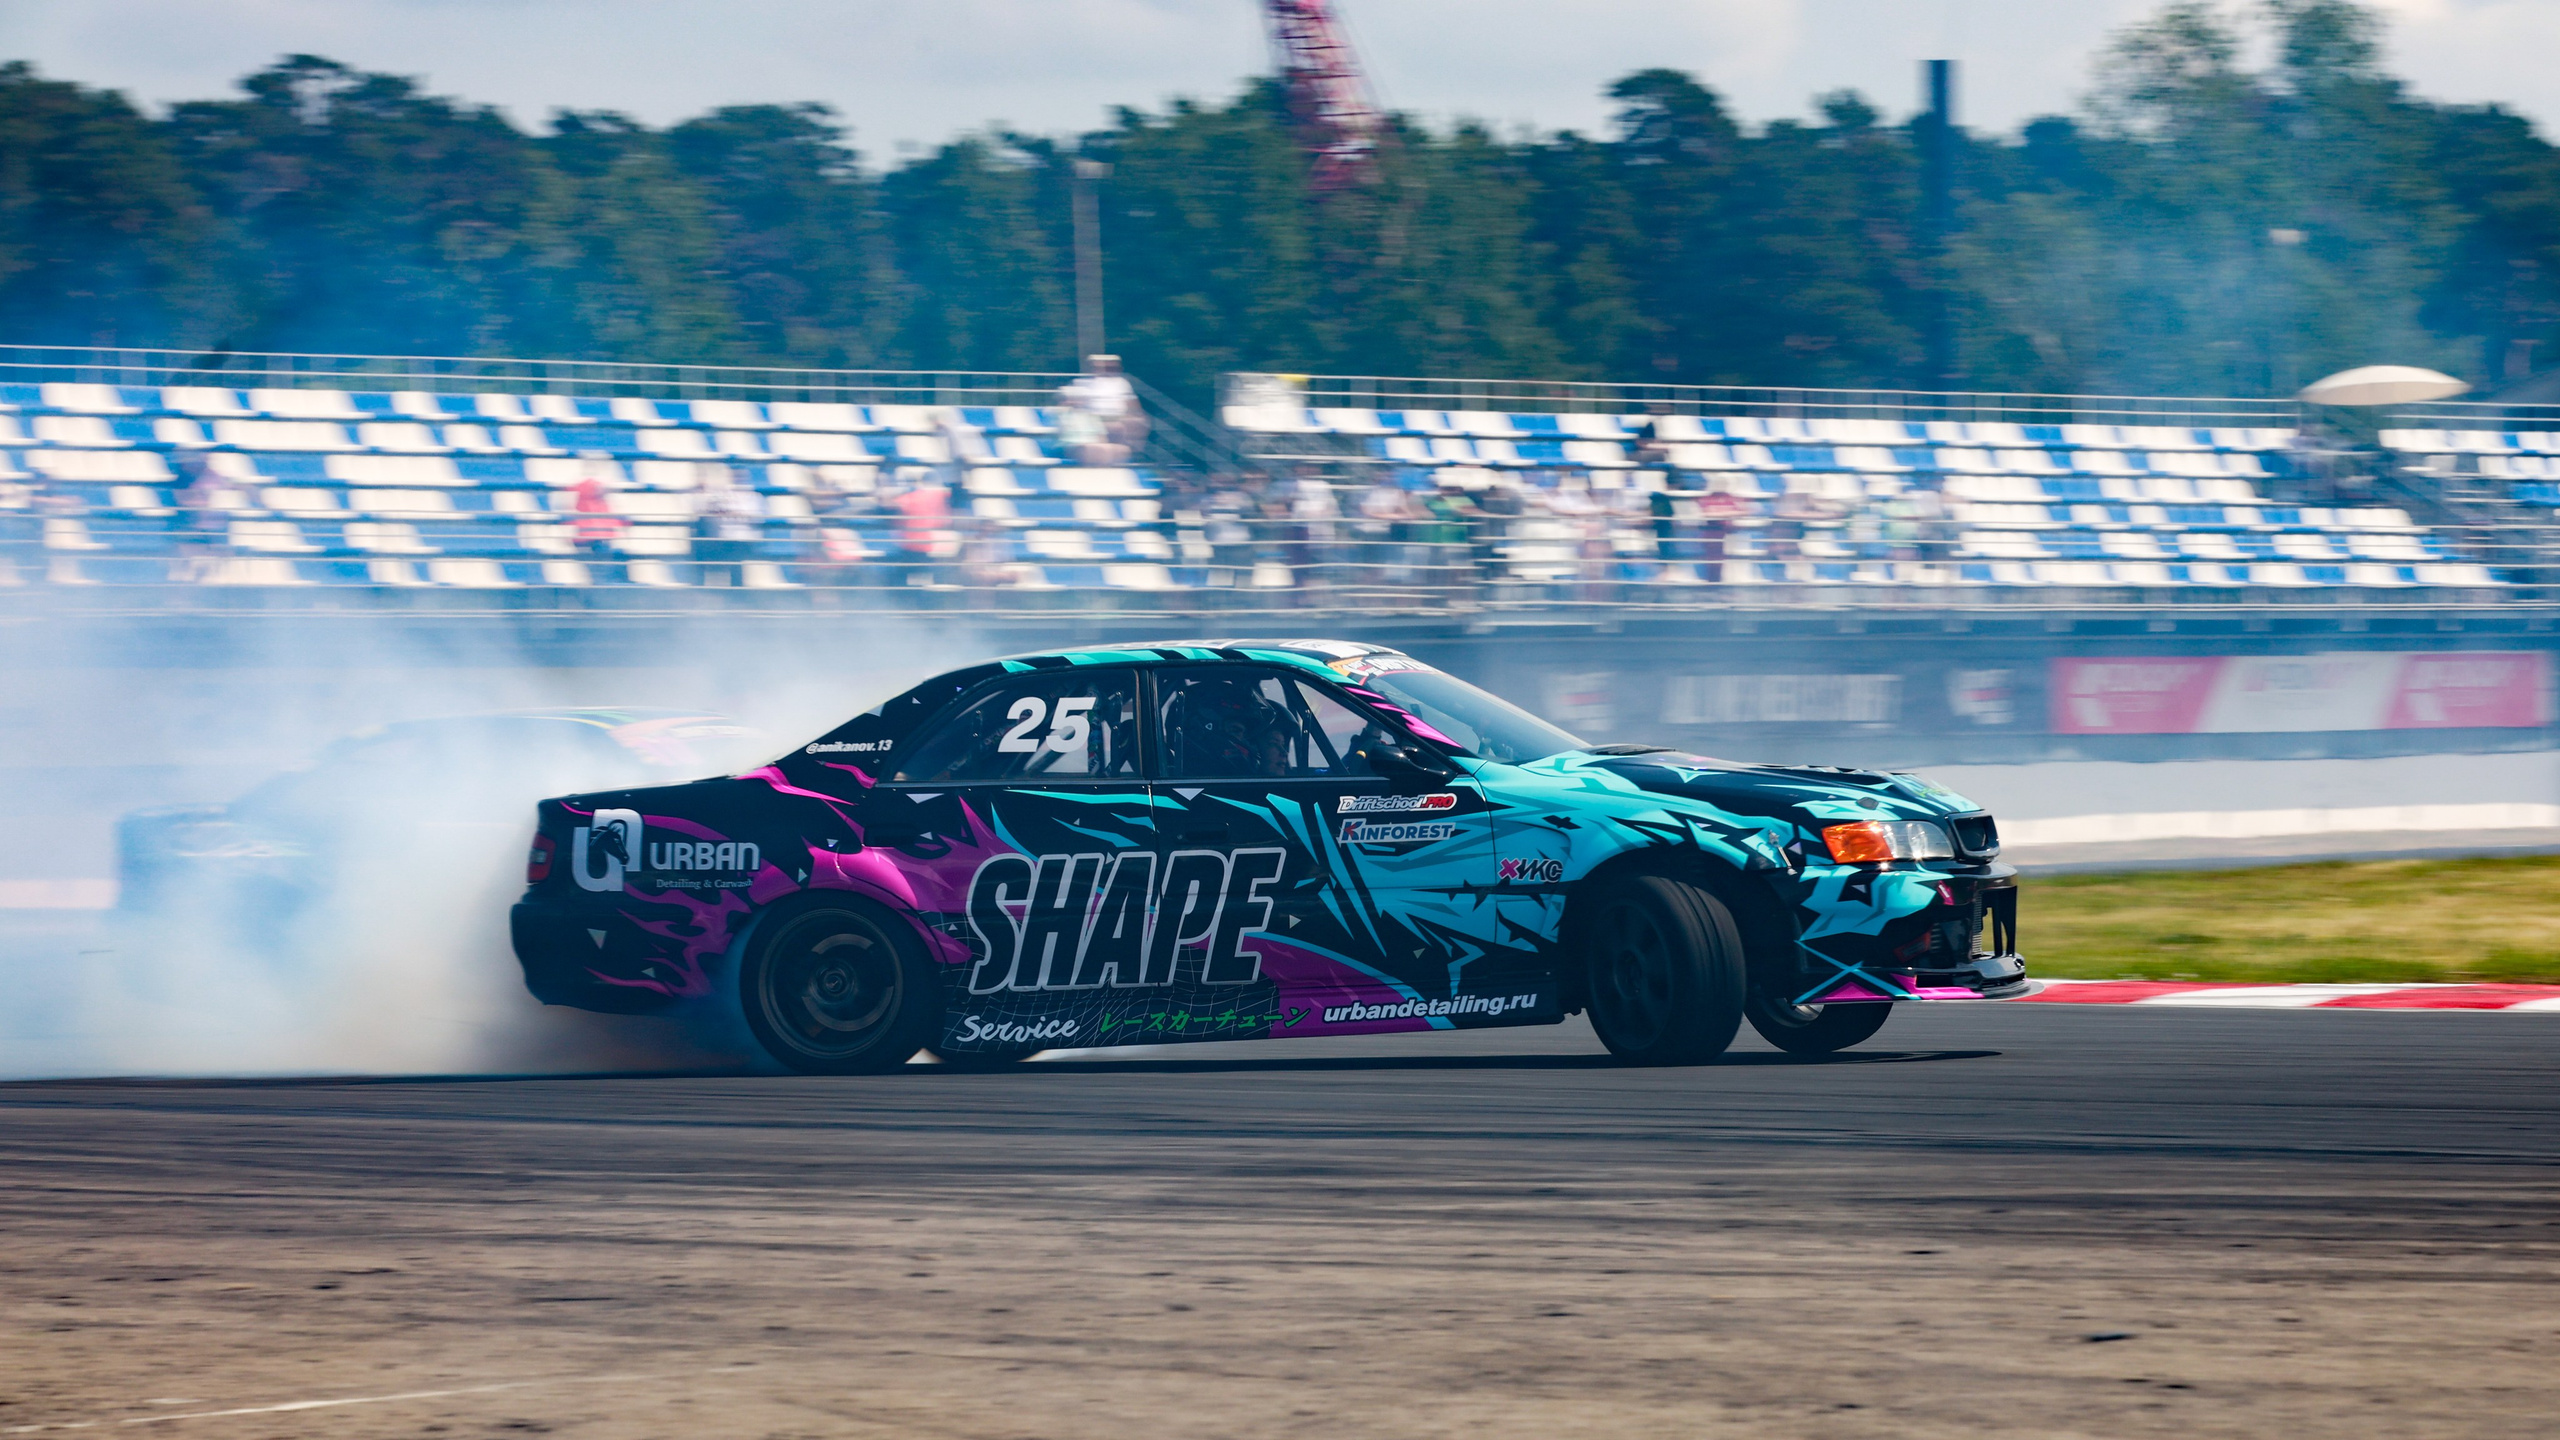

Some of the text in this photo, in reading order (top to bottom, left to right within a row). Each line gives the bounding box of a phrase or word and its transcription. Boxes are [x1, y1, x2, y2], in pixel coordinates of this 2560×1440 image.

[997, 696, 1096, 752] 25
[1341, 819, 1454, 841] KINFOREST
[650, 842, 760, 870] URBAN
[656, 878, 753, 889] Detailing & Carwash
[966, 847, 1286, 995] SHAPE
[1100, 1007, 1311, 1034] レースカーチューン
[1324, 994, 1537, 1021] urbandetailing.ru
[956, 1015, 1080, 1043] Service
